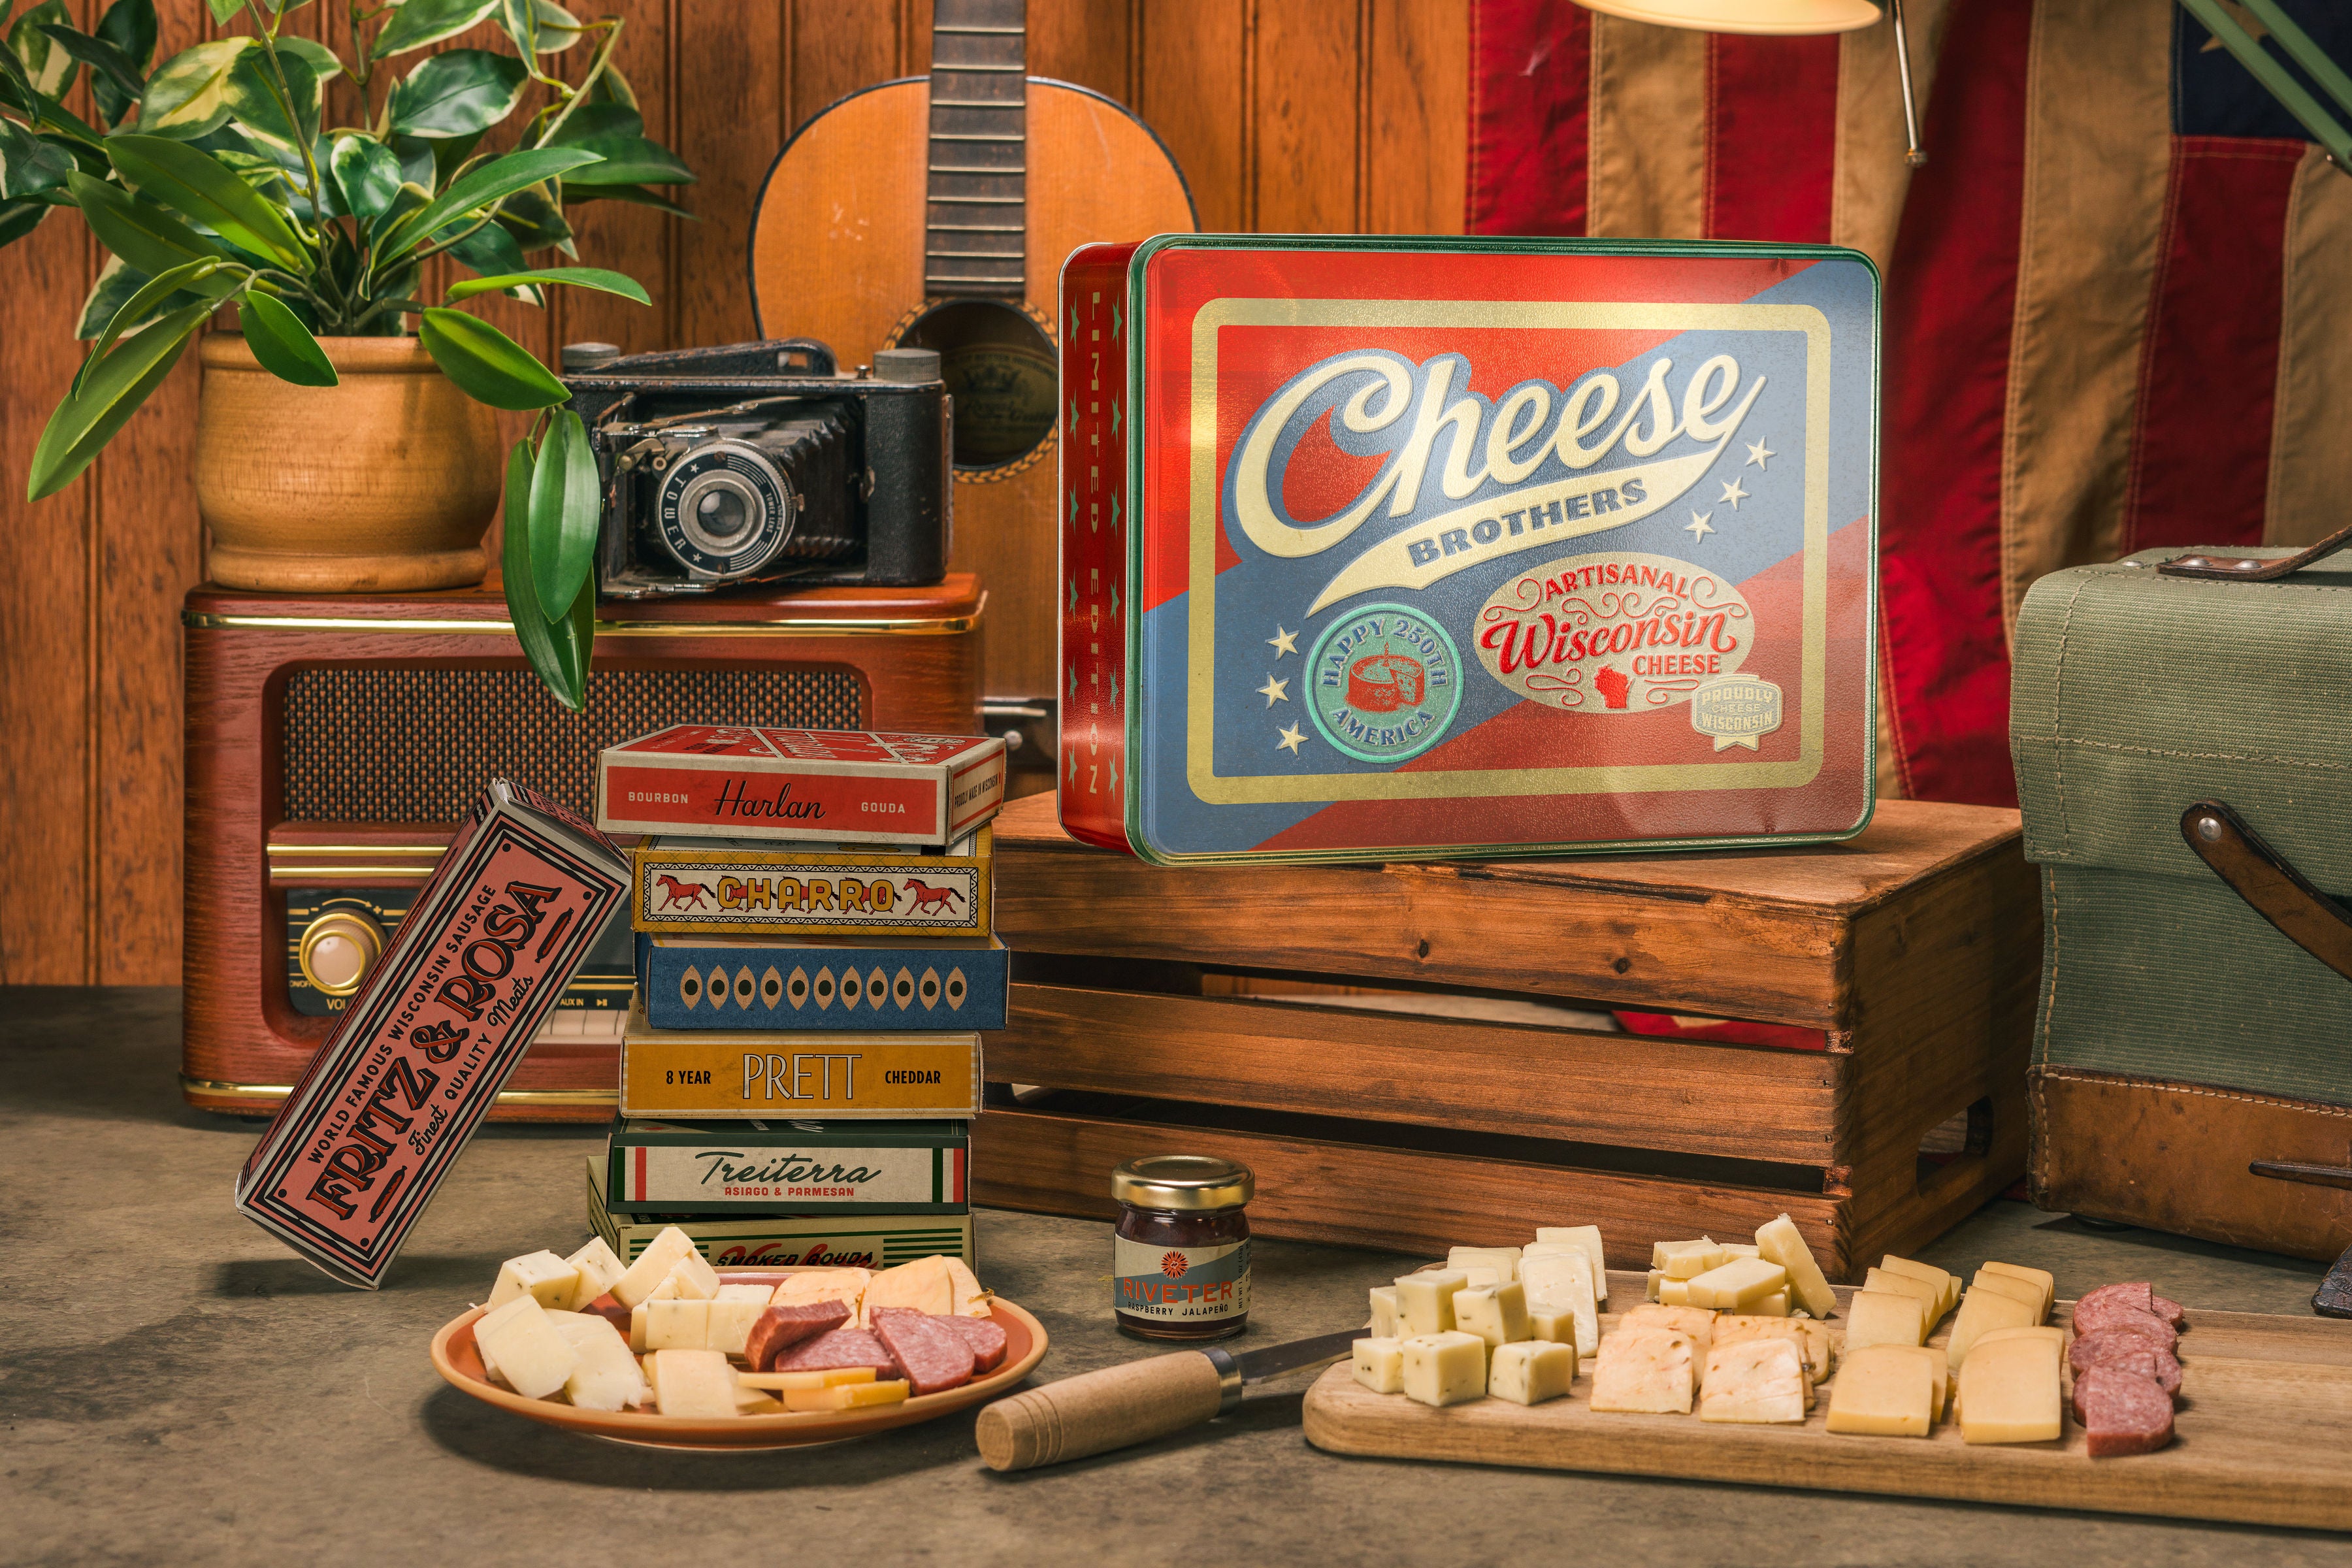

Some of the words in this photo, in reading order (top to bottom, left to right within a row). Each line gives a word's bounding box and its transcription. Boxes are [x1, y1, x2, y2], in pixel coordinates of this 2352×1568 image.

[1091, 291, 1100, 534] LIMITED
[1236, 355, 1768, 558] Cheese
[664, 476, 687, 550] TOWER
[1408, 478, 1647, 567] BROTHERS
[1544, 563, 1688, 600] ARTISANAL
[1322, 618, 1386, 687] HAPPY
[1392, 617, 1447, 687] 250TH
[1480, 610, 1737, 674] Wisconsin
[1089, 568, 1098, 794] EDITION
[1632, 655, 1720, 677] CHEESE
[1701, 687, 1773, 705] PROUDLY
[1712, 703, 1761, 713] CHEESE
[1331, 708, 1435, 747] AMERICA
[1701, 711, 1773, 730] WISCONSIN
[628, 791, 689, 804] BOURBON
[715, 779, 826, 820] Harlan
[860, 801, 906, 813] GOUDA
[969, 785, 977, 800] MADE
[983, 774, 998, 793] WISCONSIN
[717, 877, 894, 913] CHARRO
[434, 880, 562, 1021] ROSA
[308, 1119, 349, 1164] WORLD
[346, 1043, 392, 1105] FAMOUS
[387, 958, 451, 1040] WISCONSIN
[447, 885, 495, 954] SAUSAGE
[409, 1020, 469, 1063] &
[408, 1105, 448, 1156] Finest
[444, 1034, 494, 1100] QUALITY
[487, 975, 534, 1028] Meats
[666, 1070, 674, 1085] 8
[678, 1070, 711, 1085] YEAR
[742, 1053, 862, 1100] PRETT
[885, 1070, 941, 1085] CHEDDAR
[305, 1056, 438, 1220] FRITZ
[695, 1152, 882, 1184] Treiterra
[725, 1187, 770, 1196] ASIAGO
[774, 1187, 782, 1196] &
[788, 1187, 855, 1196] PARMESAN
[715, 1254, 798, 1266] SMOKED
[806, 1252, 873, 1265] GOUDA
[1123, 1277, 1233, 1303] RIVETER
[1128, 1301, 1173, 1316] RASPBERRY
[1182, 1303, 1228, 1316] JALAPEÑO
